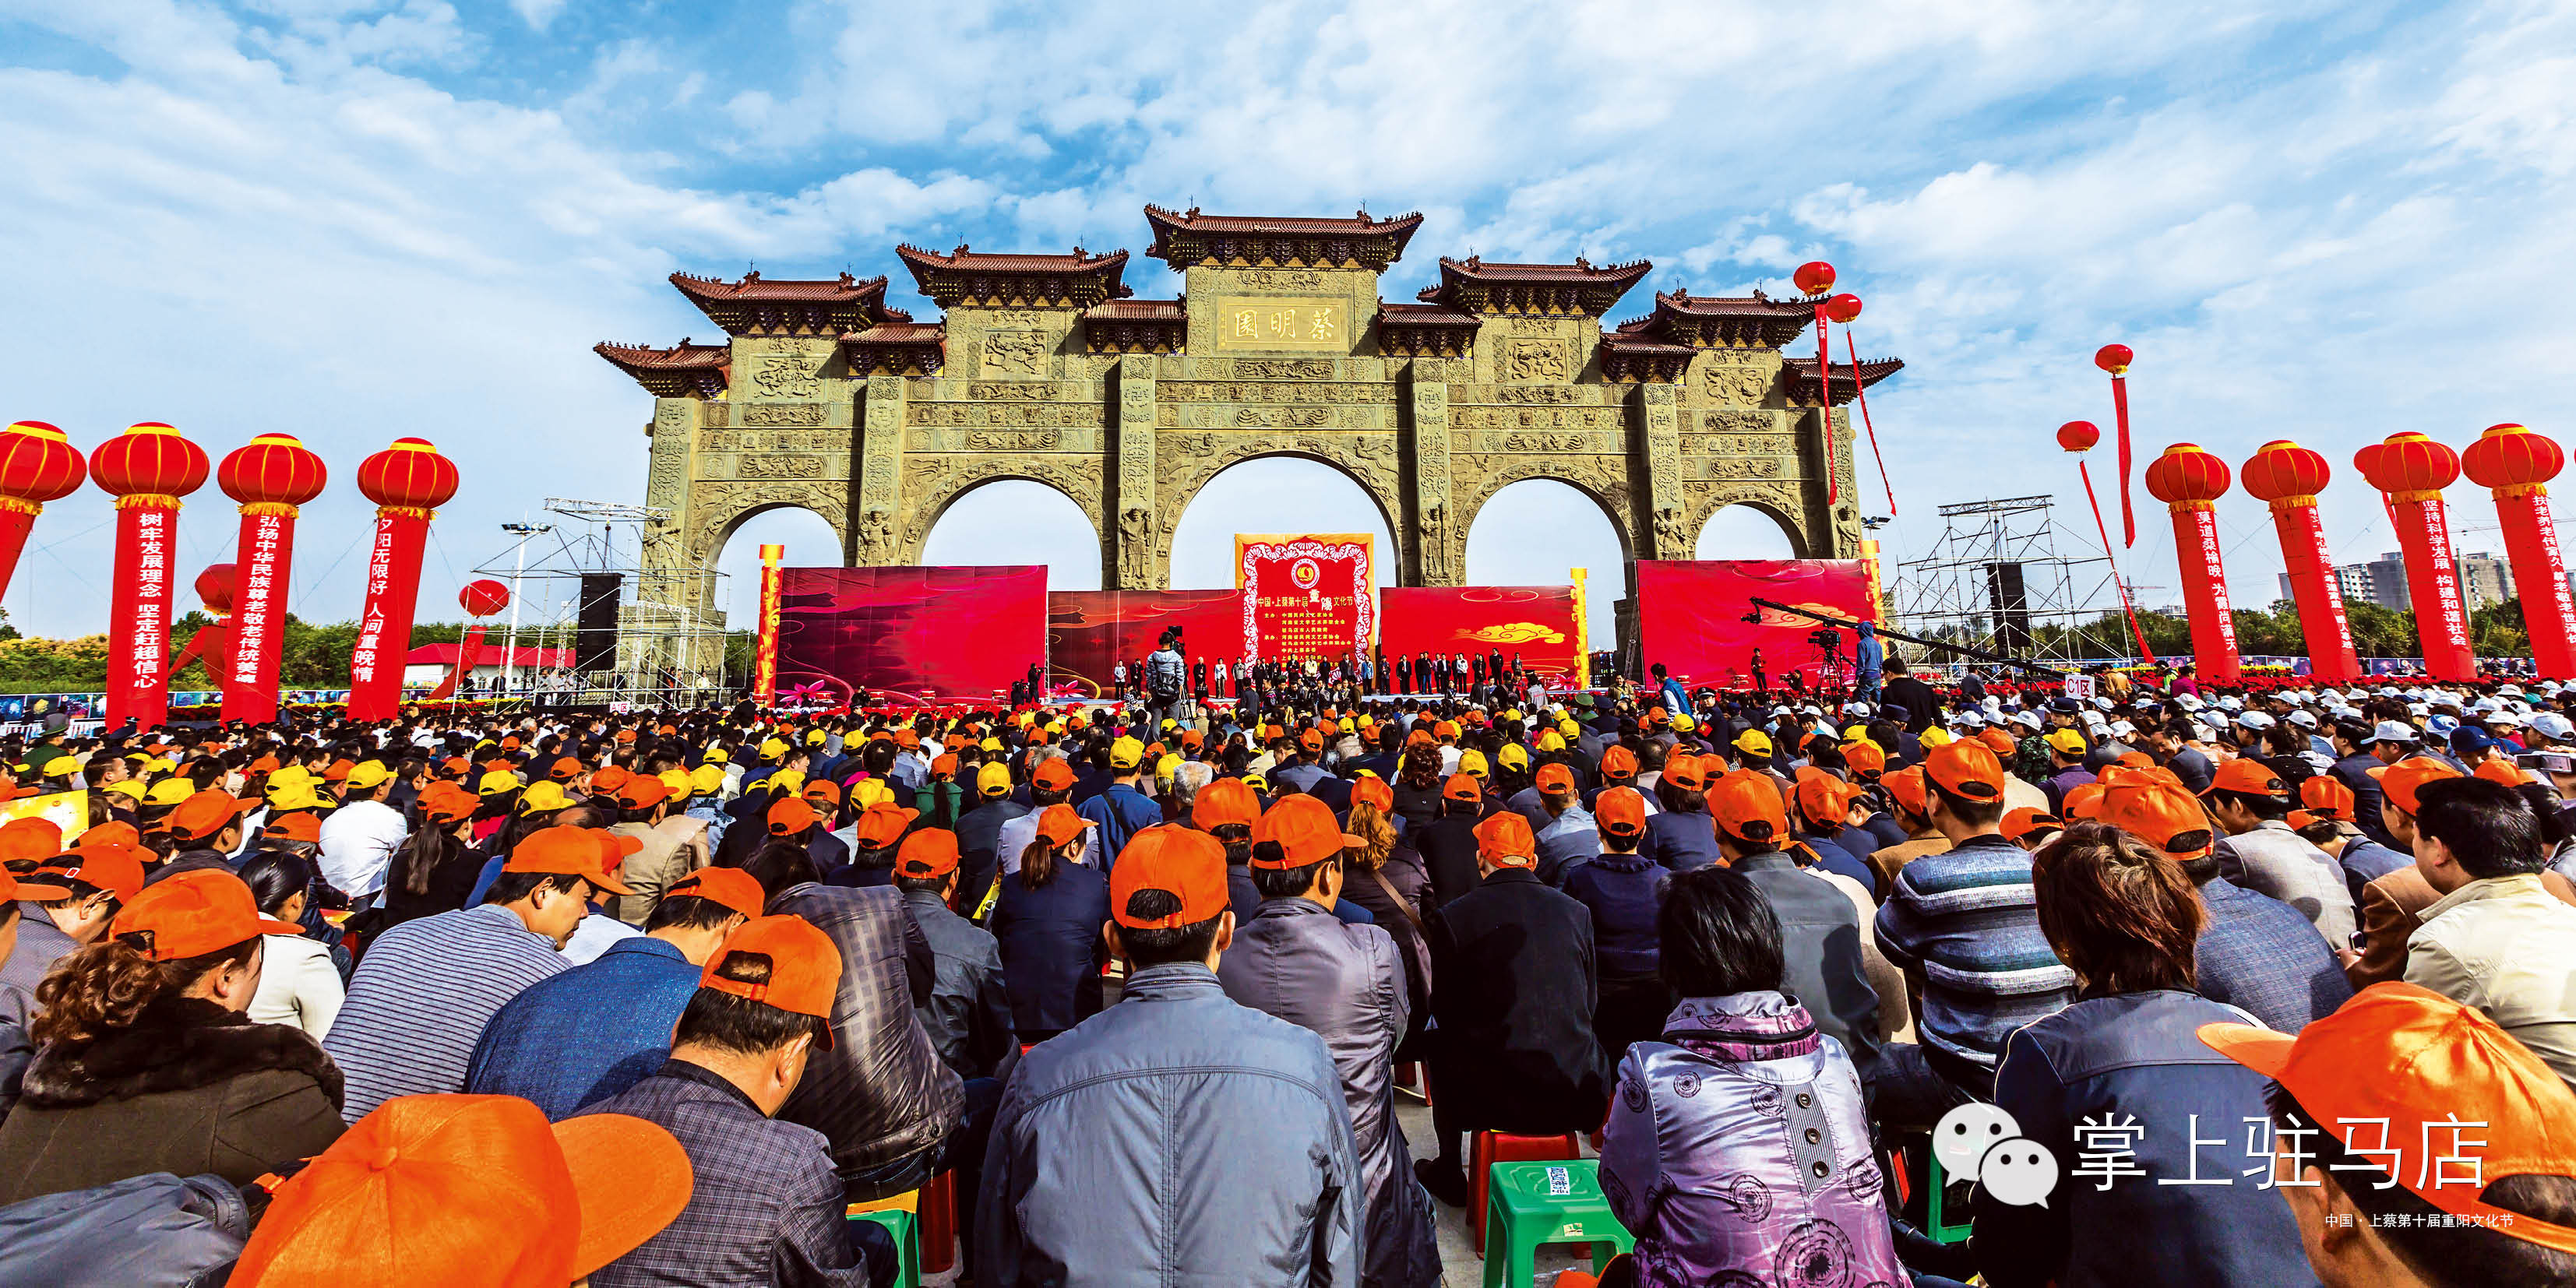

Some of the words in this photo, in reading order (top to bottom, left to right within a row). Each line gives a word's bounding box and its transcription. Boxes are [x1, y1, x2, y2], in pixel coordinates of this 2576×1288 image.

[139, 512, 164, 597] 树牢发展理念
[370, 517, 393, 595] 夕阳无限好
[2423, 500, 2451, 569] 坚持科学发展
[234, 516, 280, 684] 弘扬中华民族尊老敬老传统美德
[2196, 511, 2222, 577] 莫道桑榆晚
[2211, 583, 2236, 651] 为霞尚满天
[2436, 575, 2467, 646] 构建和谐社会
[133, 604, 160, 688] 坚定赶超信心
[353, 602, 385, 682] 人间重晚情
[611, 703, 627, 712] A1区
[2067, 678, 2090, 697] C1区
